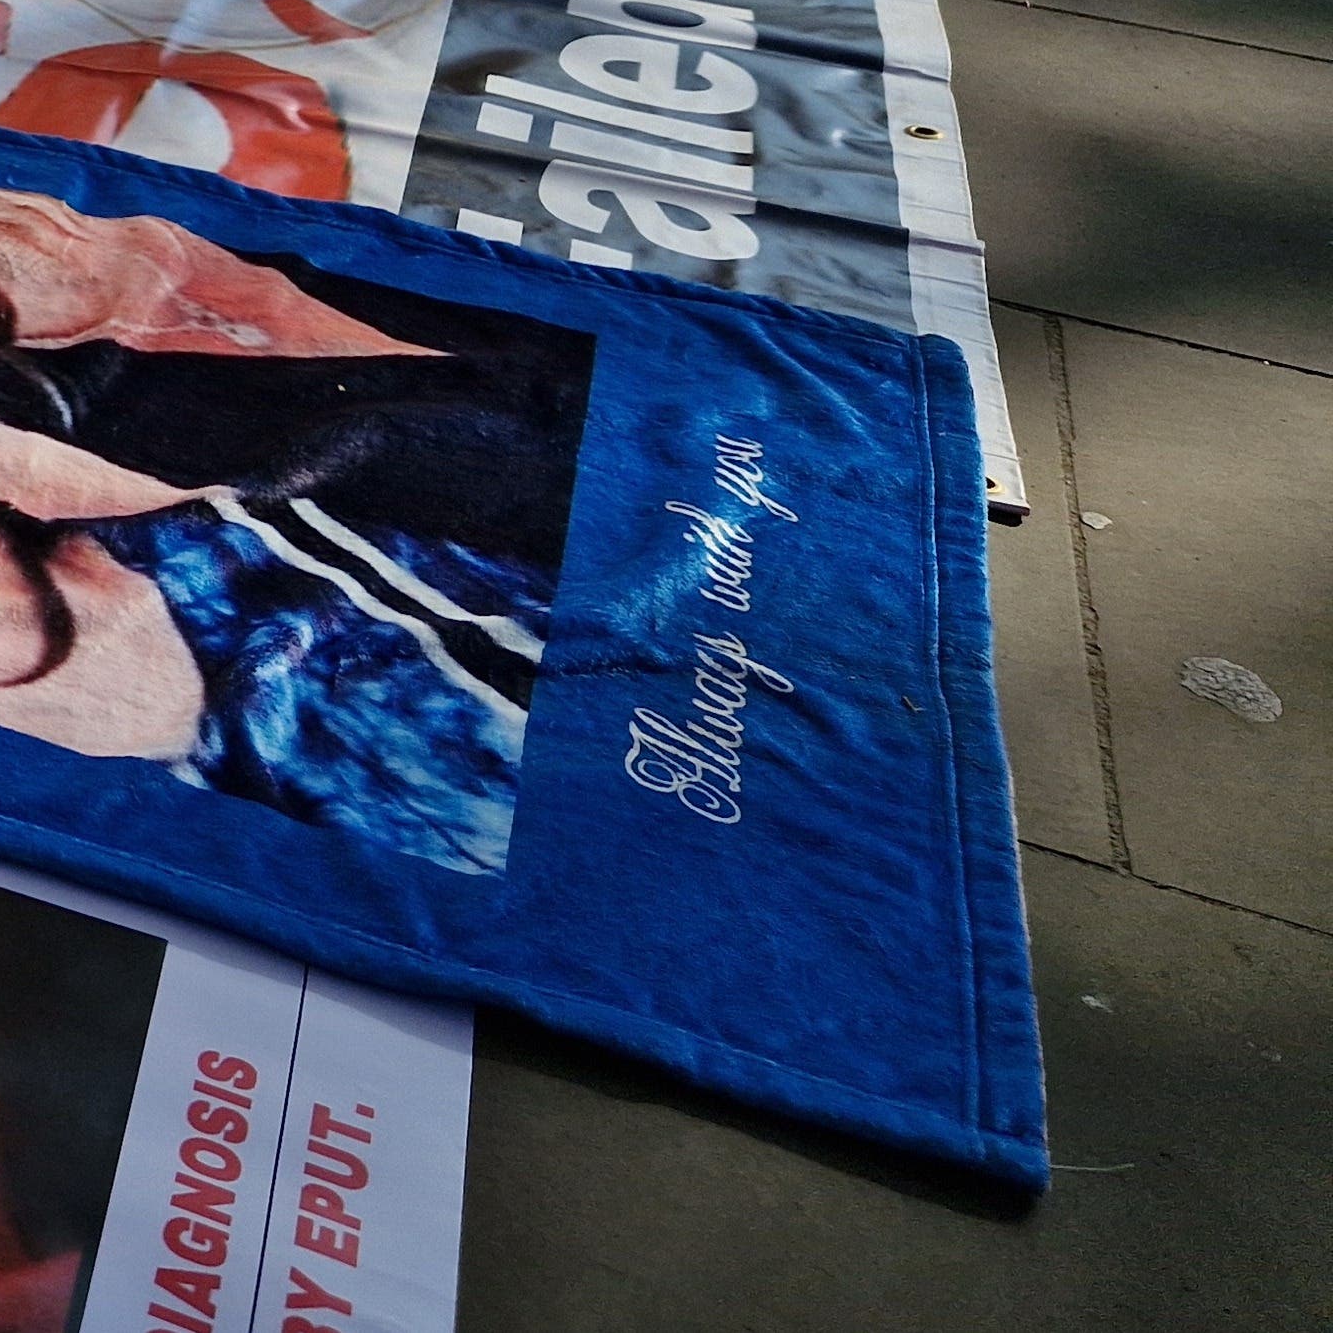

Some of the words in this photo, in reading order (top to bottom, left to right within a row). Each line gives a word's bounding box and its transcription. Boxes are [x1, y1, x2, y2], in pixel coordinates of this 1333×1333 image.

[664, 501, 755, 612] with
[715, 433, 799, 522] you
[624, 631, 795, 825] Always
[145, 1049, 259, 1333] IAGNOSIS
[293, 1102, 376, 1268] EPUT.
